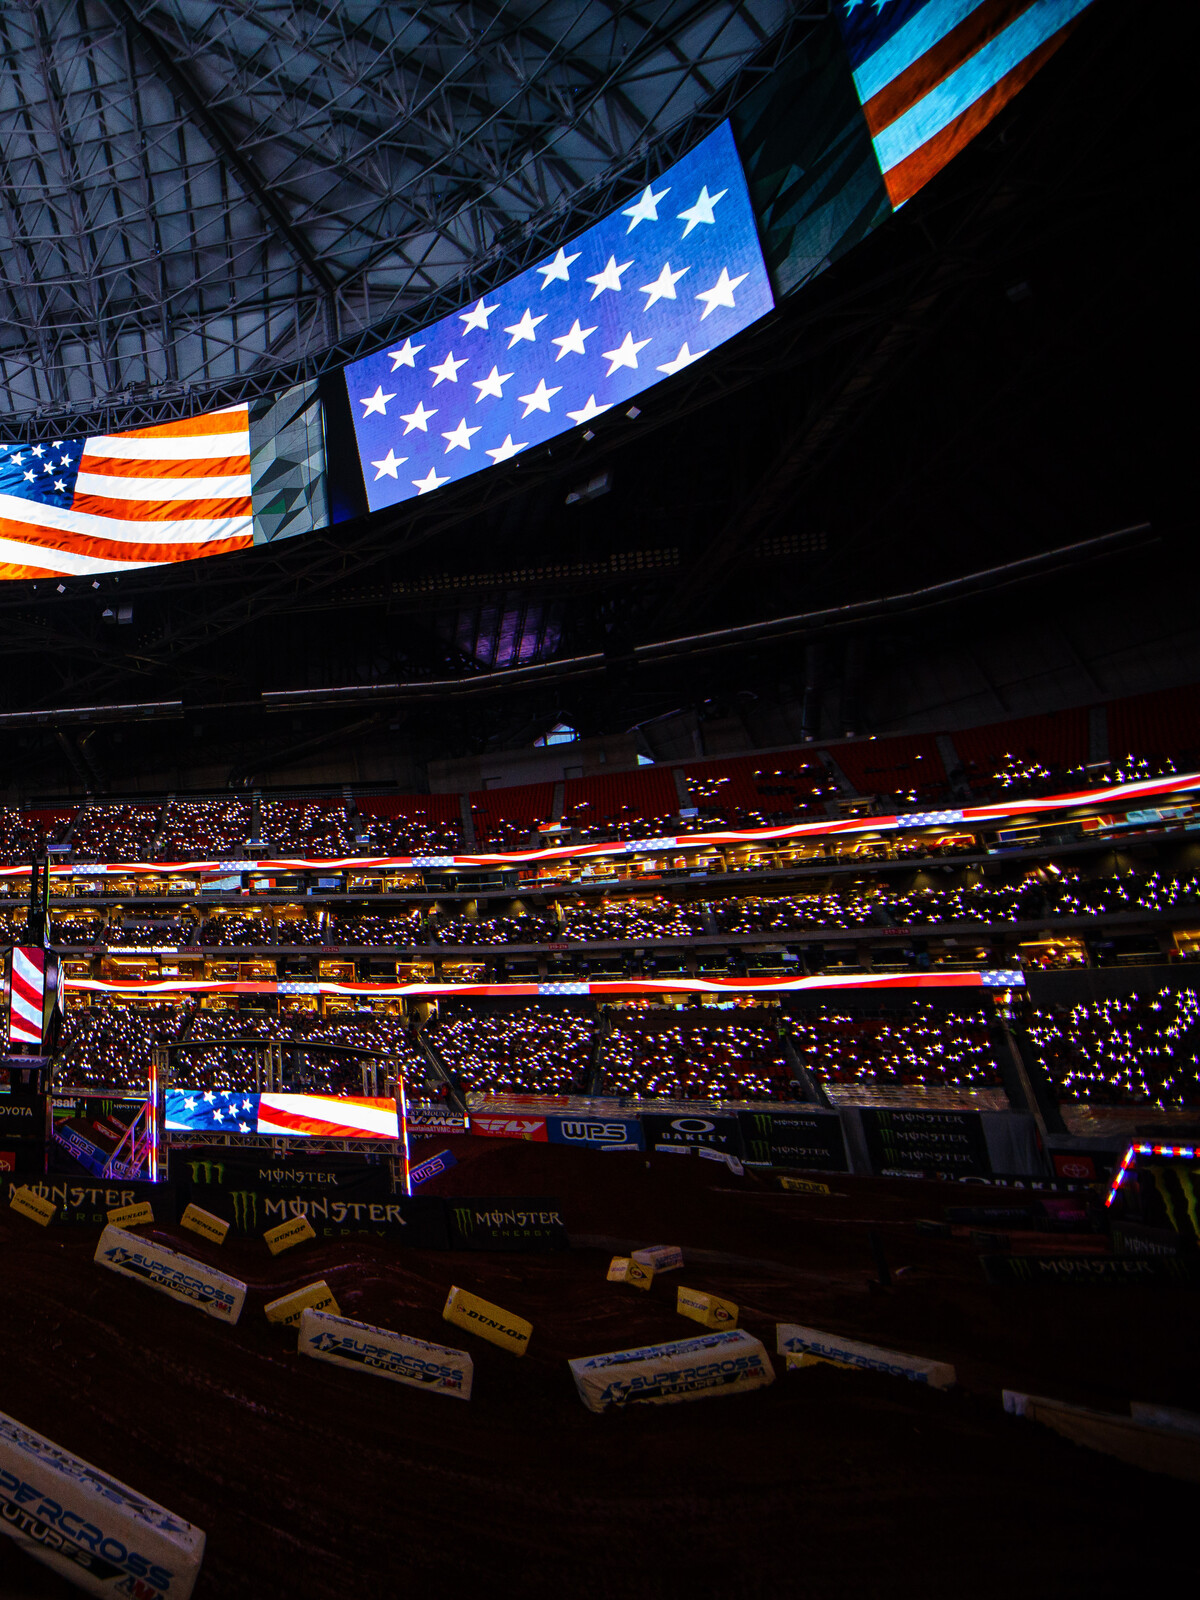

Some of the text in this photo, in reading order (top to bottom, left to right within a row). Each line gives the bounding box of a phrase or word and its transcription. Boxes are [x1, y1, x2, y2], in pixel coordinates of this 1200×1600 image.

[108, 945, 152, 953] Mercedes-Benz
[422, 1110, 463, 1118] MOUNTAIN
[773, 1118, 818, 1128] MONSTER
[892, 1112, 967, 1124] MONSTER
[472, 1118, 545, 1133] FLY
[561, 1120, 628, 1142] WPS
[69, 1134, 96, 1155] WPS
[661, 1132, 728, 1143] OAKLEY
[896, 1131, 969, 1144] MONSTER
[772, 1144, 831, 1158] MONSTER
[900, 1149, 976, 1164] MONSTER
[259, 1167, 339, 1185] MONSTER
[410, 1158, 446, 1183] WPS
[19, 1200, 49, 1219] DUNLOP
[116, 1209, 149, 1222] DUNLOP
[263, 1195, 408, 1226] MONSTER
[476, 1208, 564, 1228] MONSTER
[191, 1217, 224, 1237] DUNLOP
[274, 1223, 306, 1243] DUNLOP
[491, 1229, 553, 1237] ENERGY
[1039, 1258, 1155, 1275] MONSTER
[132, 1253, 236, 1306] SUPERCROSS
[149, 1271, 200, 1300] FUTURES
[681, 1297, 709, 1312] DUNLOP
[466, 1309, 528, 1344] DUNLOP
[342, 1337, 464, 1381] SUPERCROSS
[363, 1356, 423, 1380] FUTURES
[810, 1341, 928, 1384] SUPERCROSS
[630, 1354, 763, 1389] SUPERCROSS
[660, 1376, 726, 1396] FUTURES
